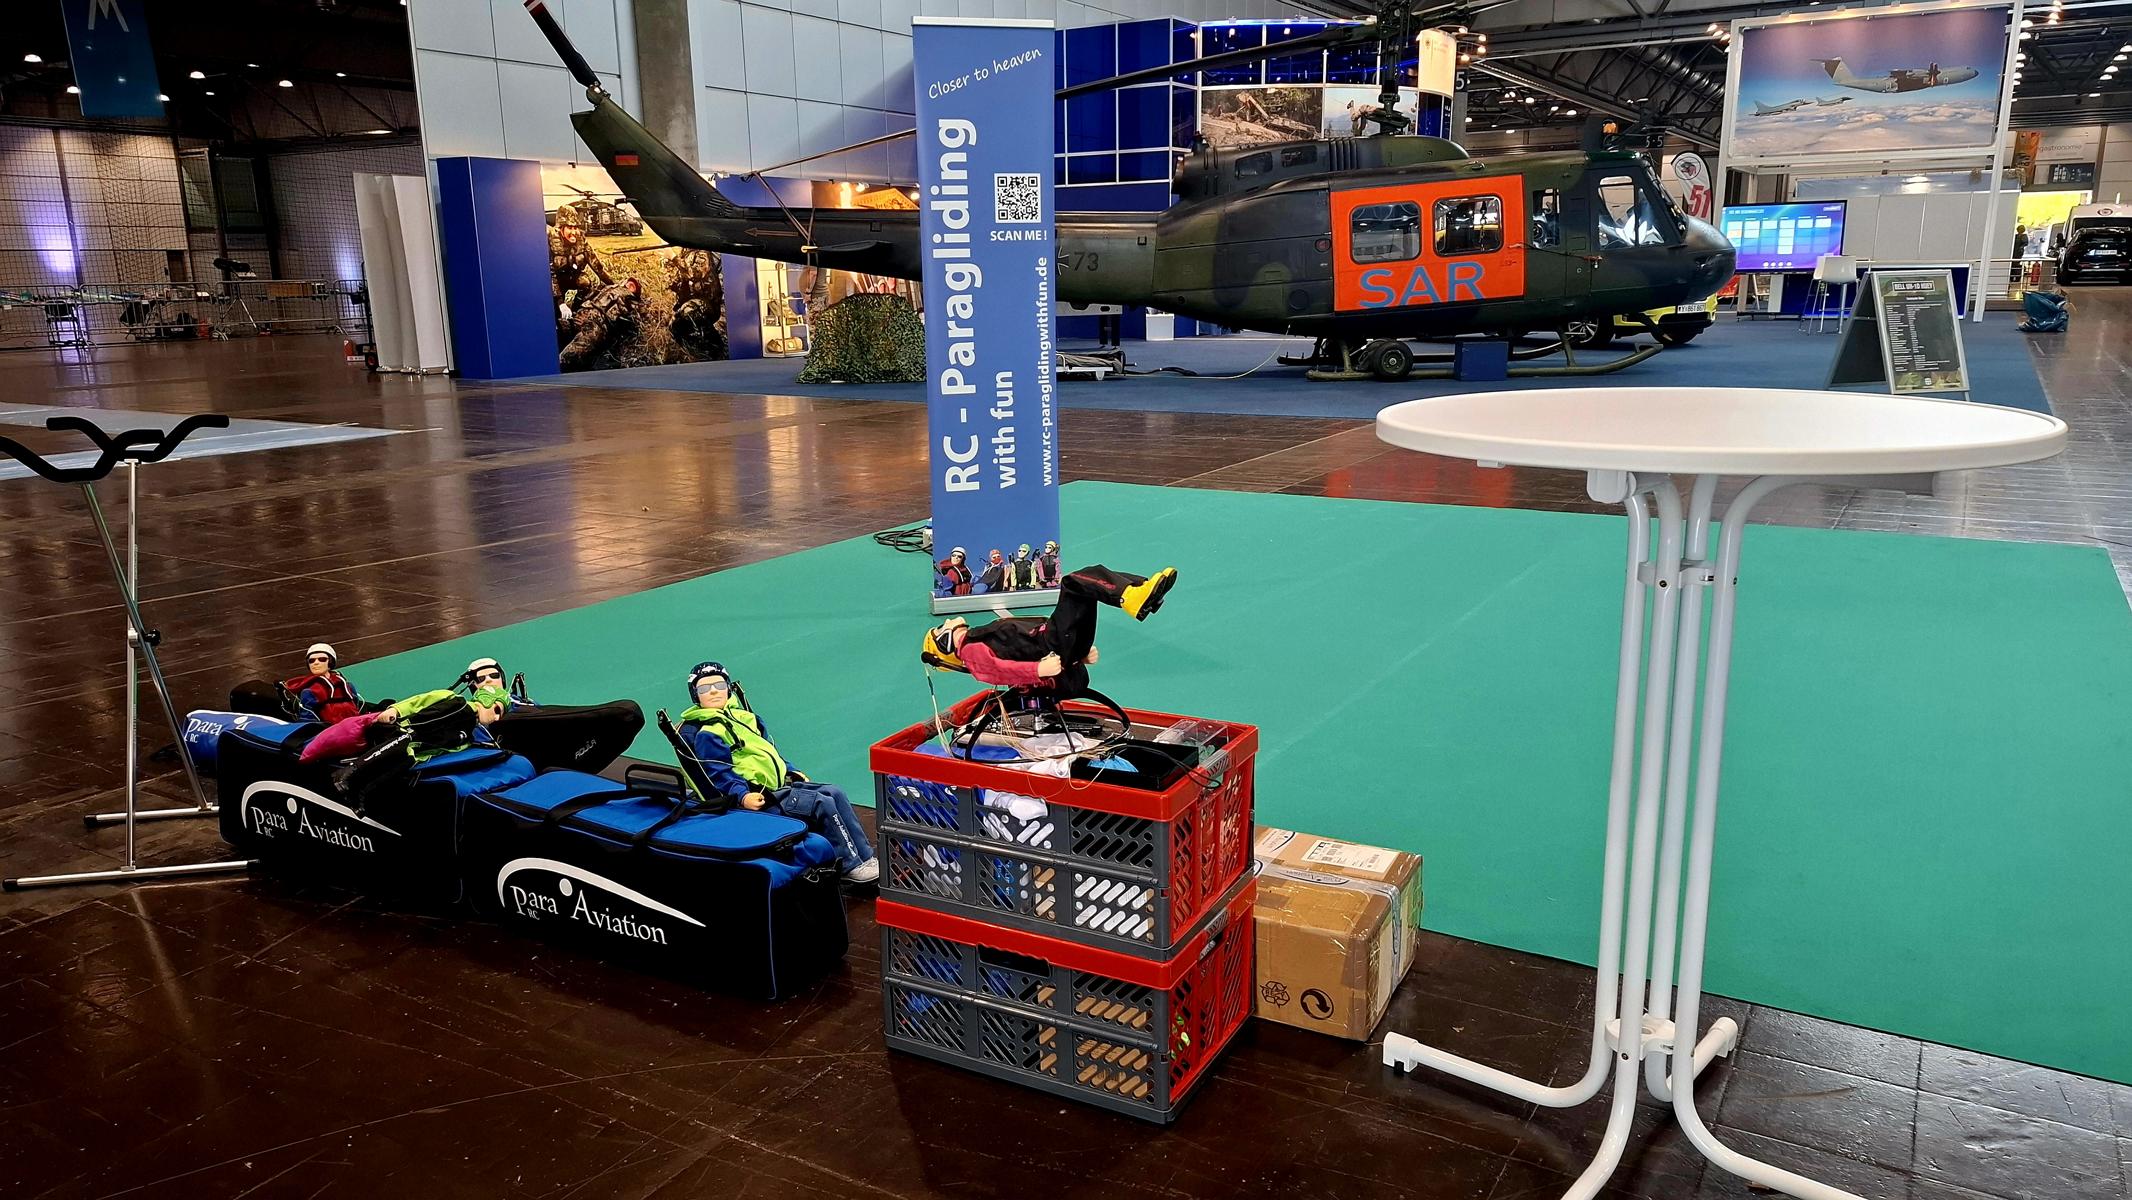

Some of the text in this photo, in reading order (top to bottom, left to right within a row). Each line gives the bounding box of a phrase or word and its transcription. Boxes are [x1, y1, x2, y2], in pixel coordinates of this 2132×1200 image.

[928, 48, 1042, 99] Closer to heaven
[1687, 184, 1712, 218] 51
[930, 118, 983, 395] Paragliding
[990, 230, 1022, 241] SCAN
[1074, 251, 1099, 272] 73
[1359, 261, 1486, 308] SAR
[1035, 256, 1053, 487] www.rc-paraglidingwithfun.de
[990, 371, 1016, 489] with fun
[943, 434, 980, 492] RC
[184, 718, 223, 741] Para
[250, 806, 376, 853] Para Aviation
[264, 826, 275, 838] RC
[510, 885, 668, 945] Para Aviation
[527, 908, 540, 920] RC
